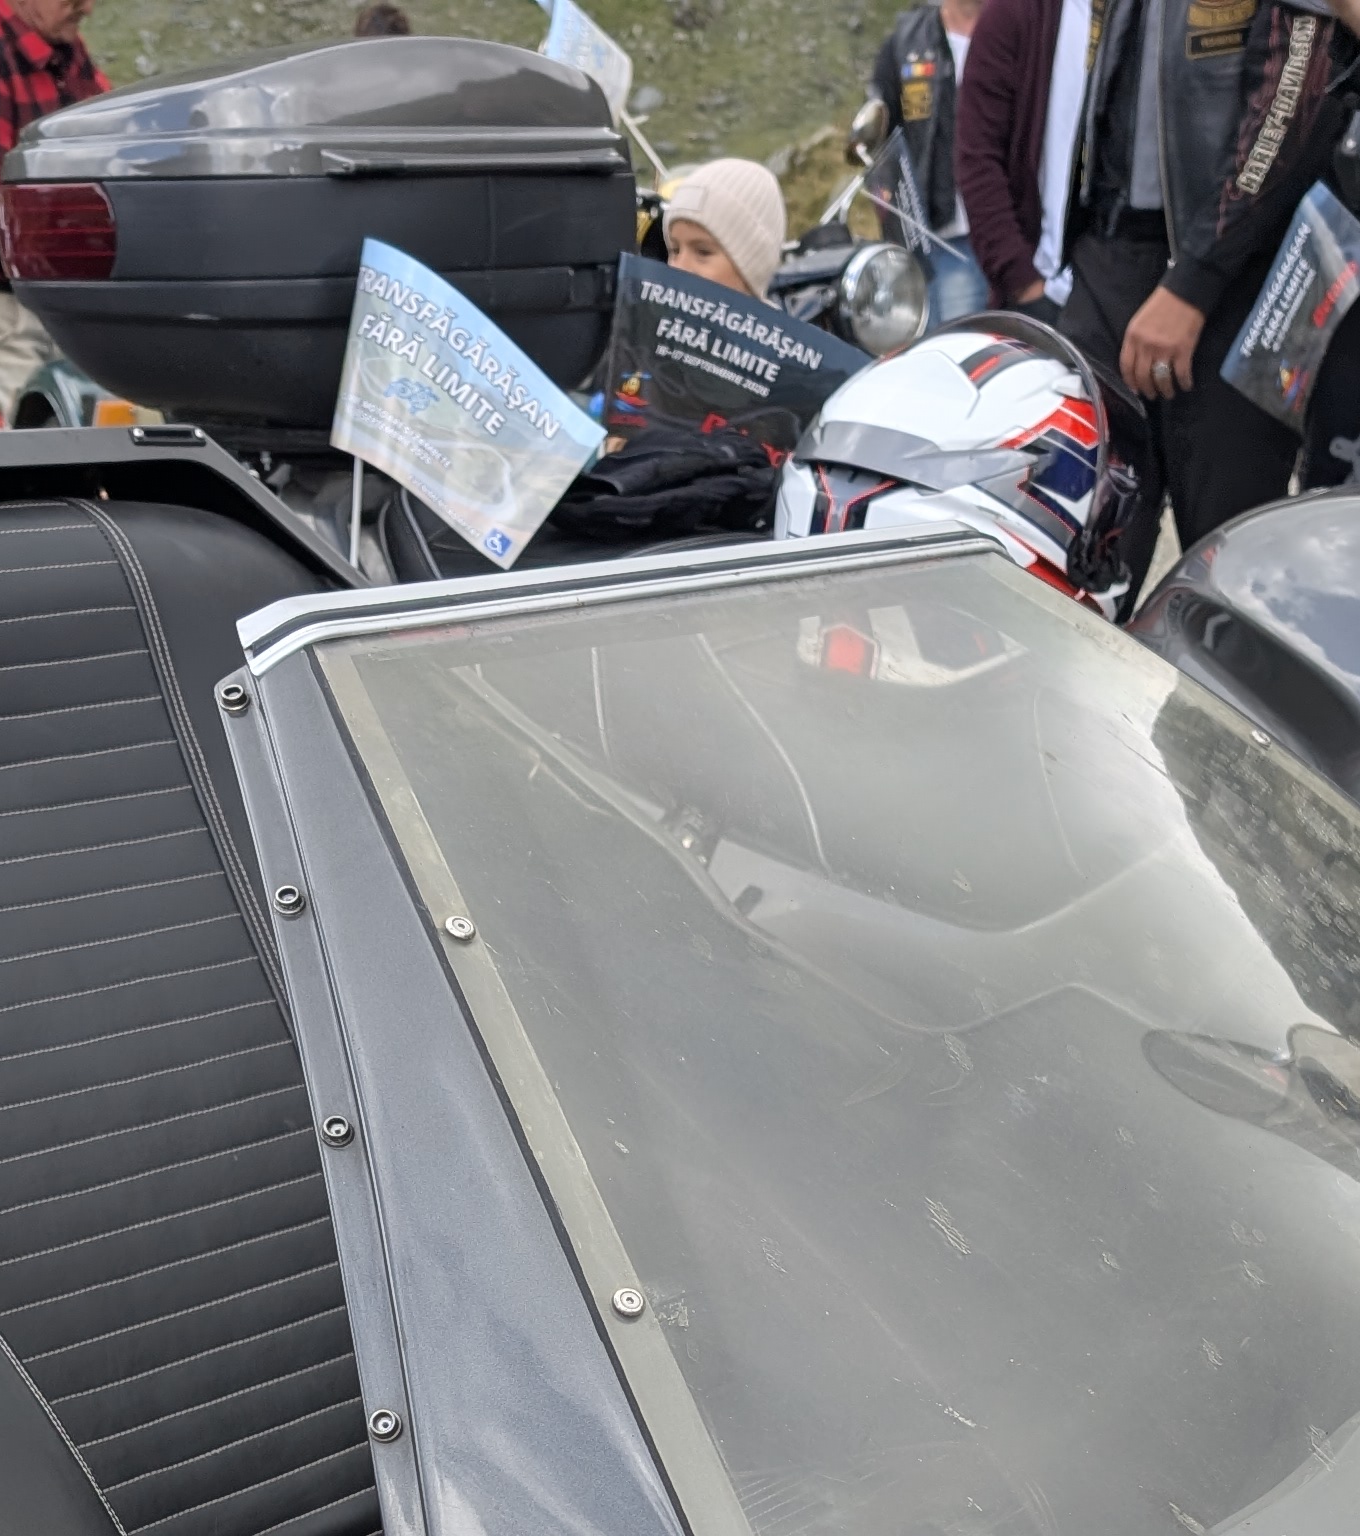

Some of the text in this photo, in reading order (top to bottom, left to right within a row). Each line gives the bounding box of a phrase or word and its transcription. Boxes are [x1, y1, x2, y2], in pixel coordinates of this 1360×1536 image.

[1236, 15, 1317, 195] HARLEY-DAVIDSON
[356, 311, 508, 437] FĂRĂ LIMITE
[656, 317, 712, 353] FĂRĂ
[710, 337, 782, 384] LIMITE
